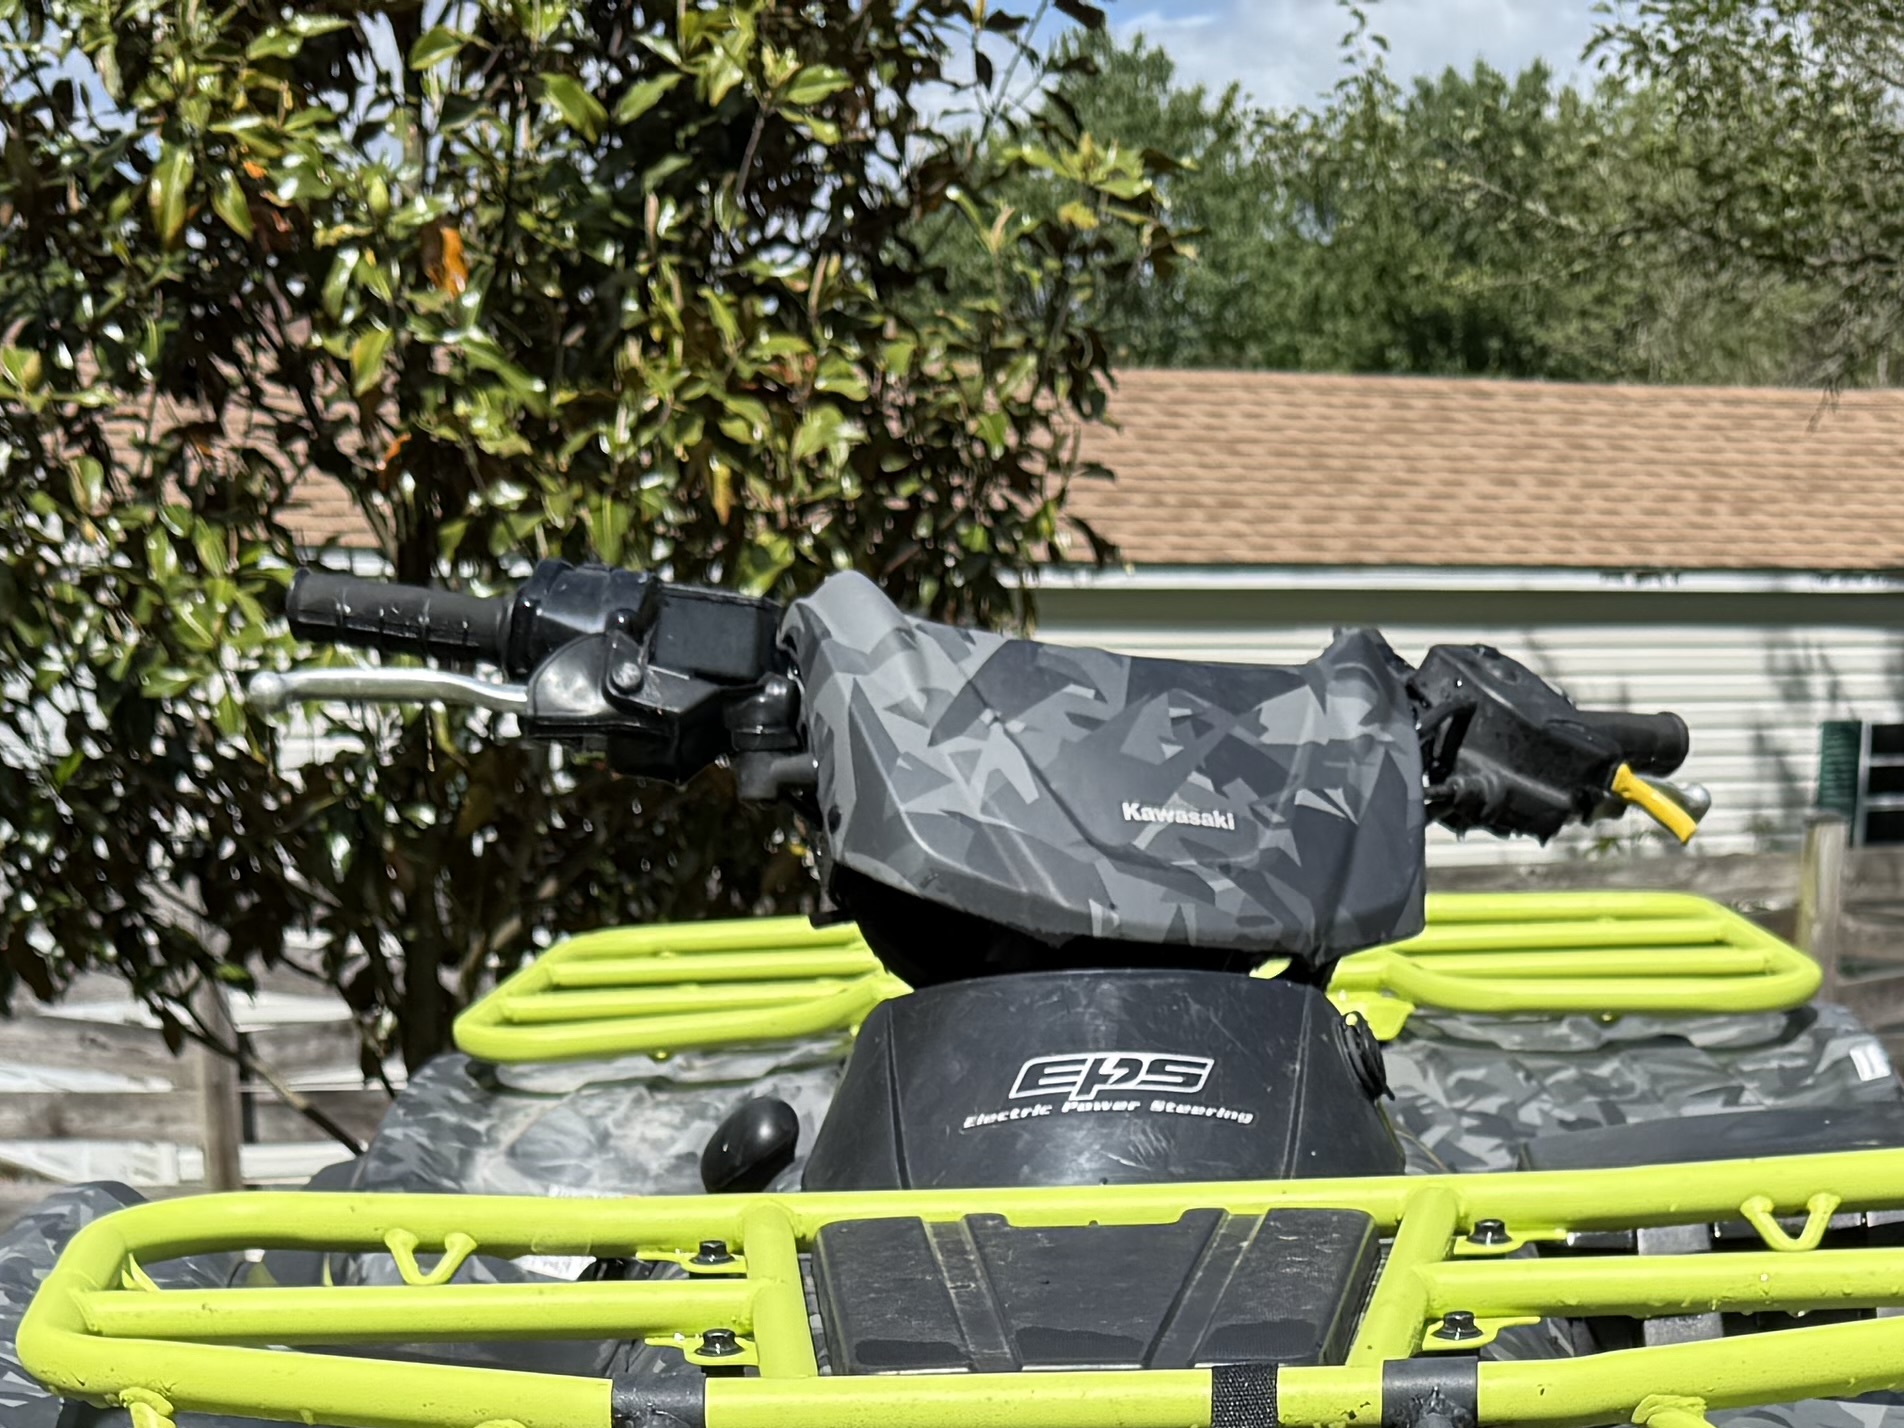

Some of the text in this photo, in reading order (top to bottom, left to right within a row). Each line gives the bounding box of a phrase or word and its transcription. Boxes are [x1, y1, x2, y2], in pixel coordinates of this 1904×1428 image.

[1121, 801, 1235, 830] Kawasaki
[1008, 1051, 1215, 1101] EPS
[962, 1099, 1254, 1129] Electric Power Steering
